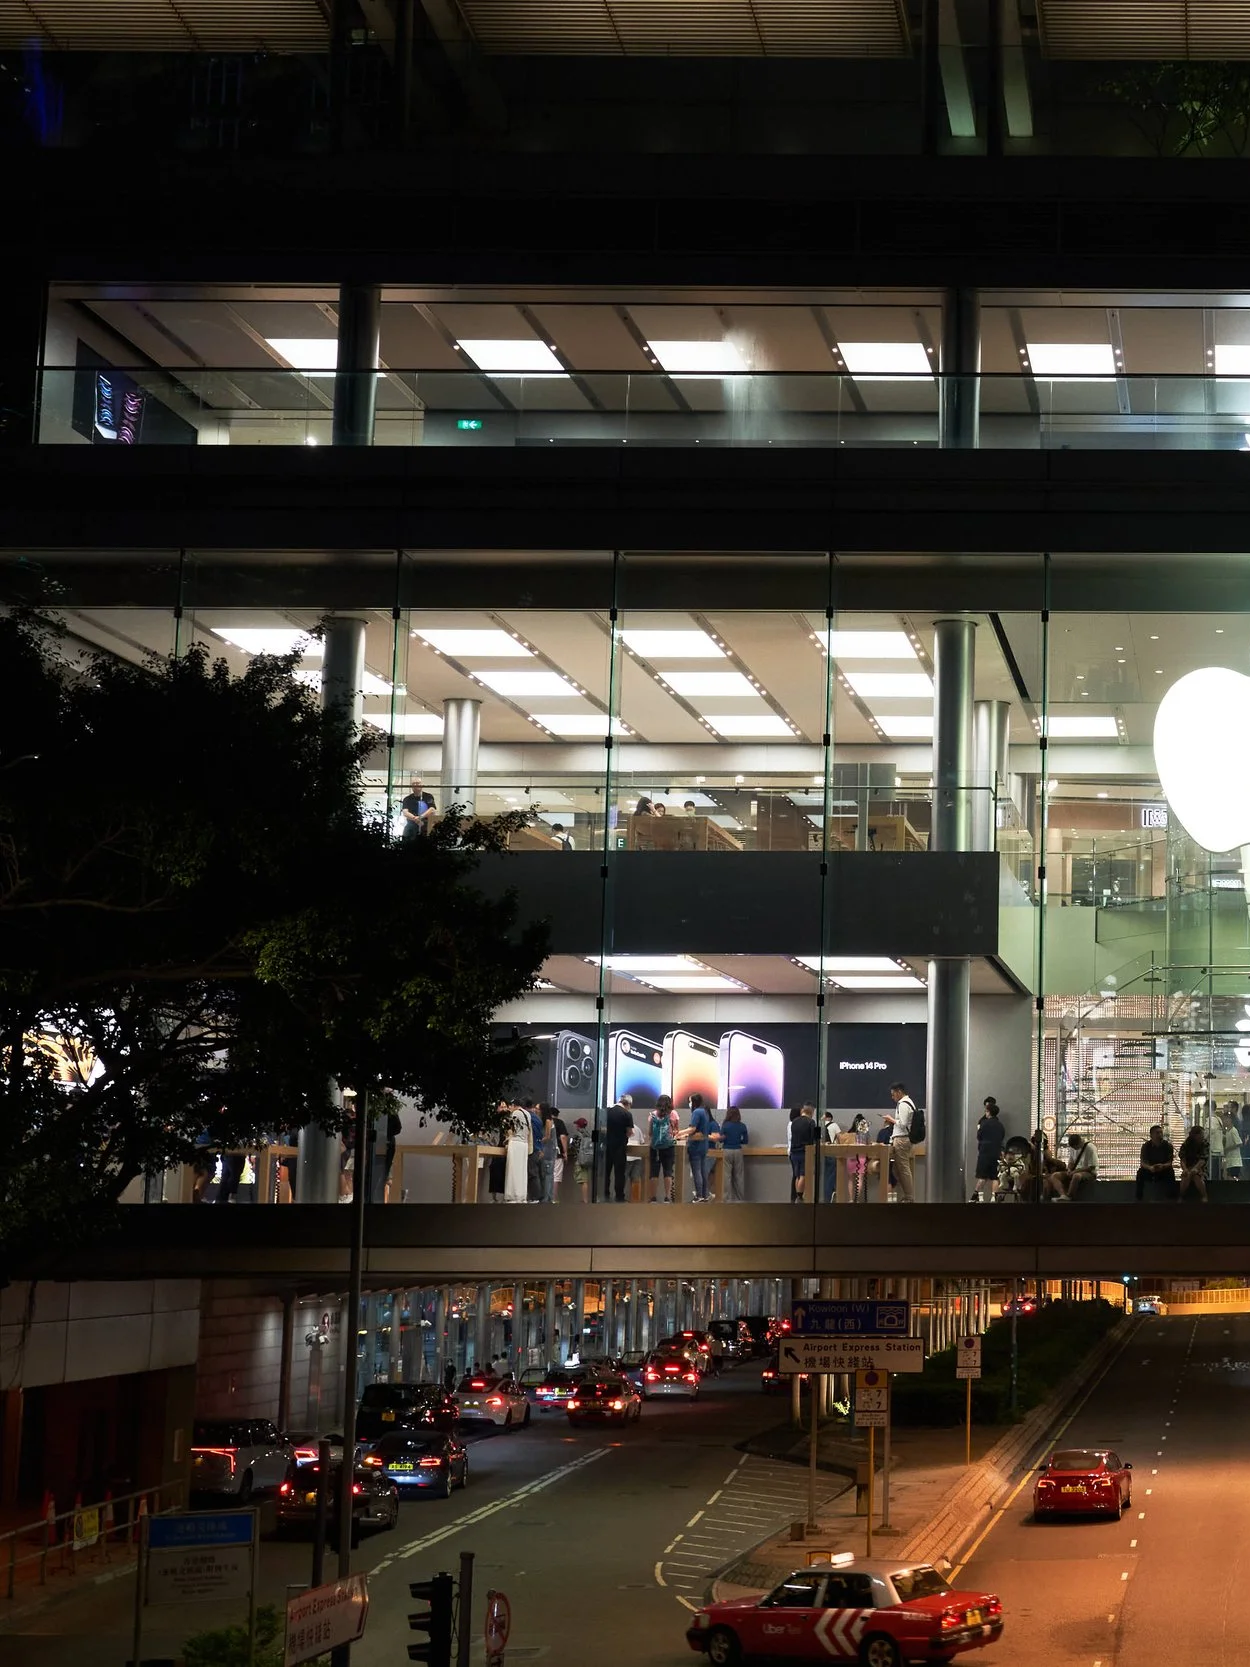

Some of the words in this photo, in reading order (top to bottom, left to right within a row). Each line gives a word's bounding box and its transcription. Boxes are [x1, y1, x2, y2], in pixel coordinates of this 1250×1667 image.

[839, 1061, 865, 1070] iPhone
[865, 1061, 873, 1070] 14
[874, 1061, 887, 1070] Pro
[808, 1304, 848, 1313] Kowloon
[852, 1303, 870, 1313] (W)
[803, 1343, 837, 1352] Airport
[842, 1343, 880, 1352] Express
[886, 1342, 921, 1352] Station
[876, 1390, 881, 1398] 7
[876, 1401, 881, 1409] 7
[763, 1623, 785, 1634] Uber
